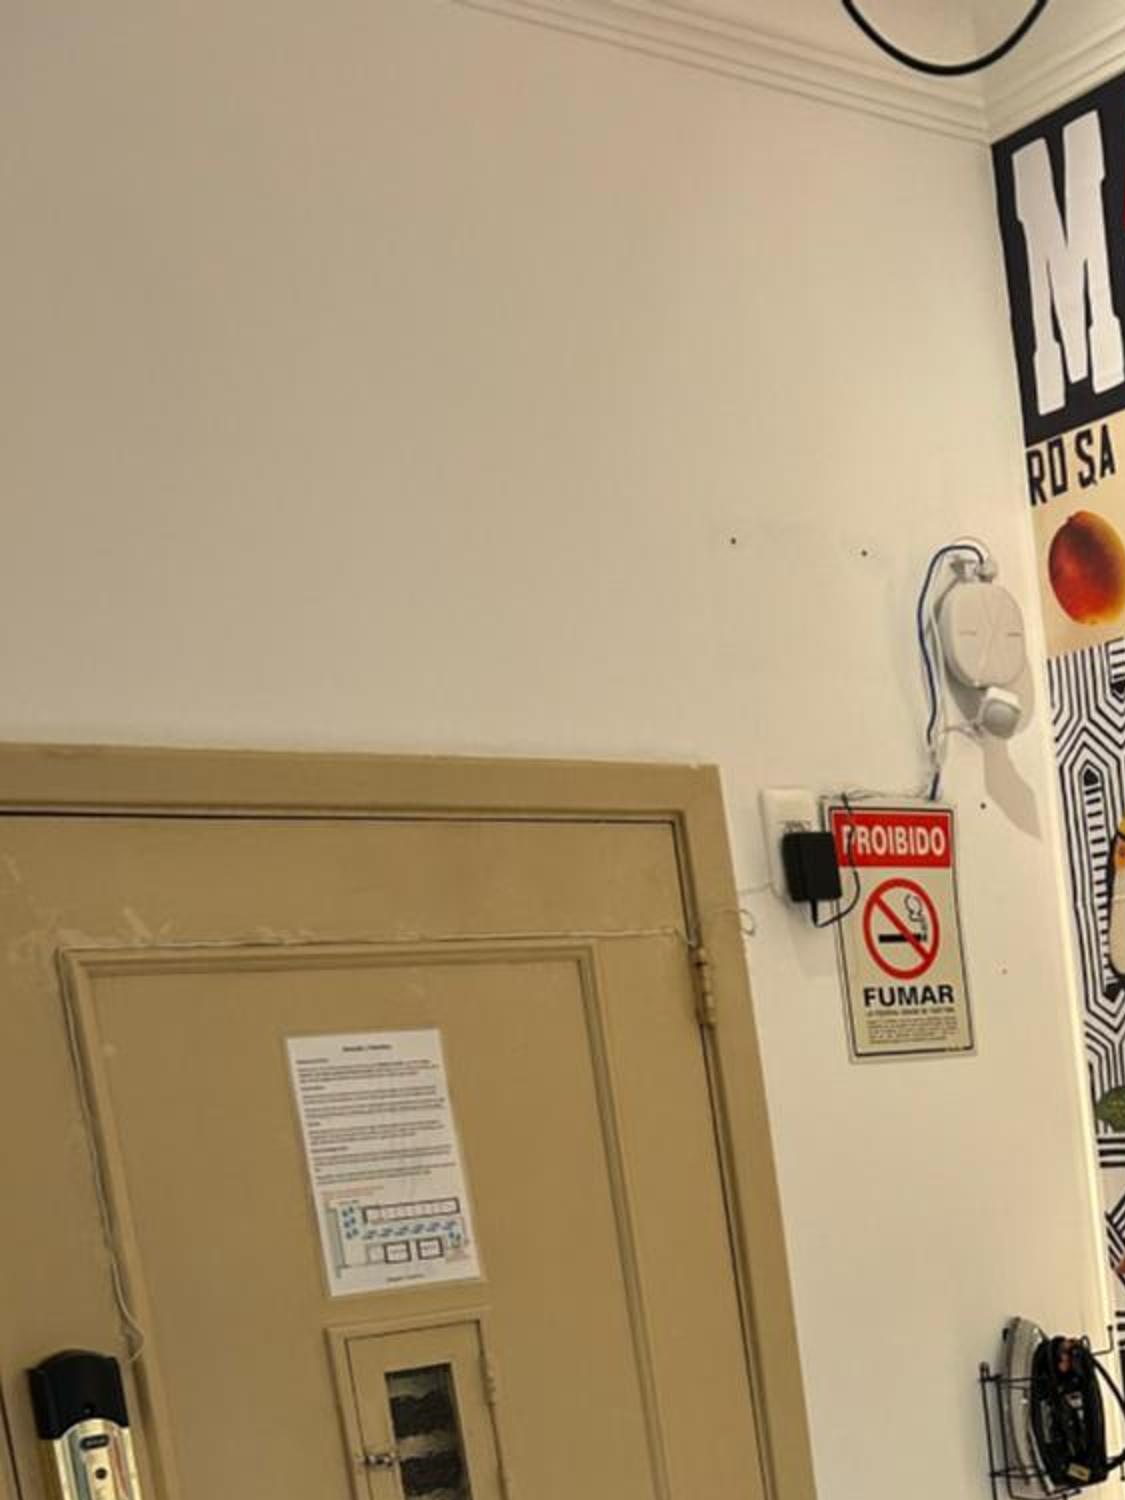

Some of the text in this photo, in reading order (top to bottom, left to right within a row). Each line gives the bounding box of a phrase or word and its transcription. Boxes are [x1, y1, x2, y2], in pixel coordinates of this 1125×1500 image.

[1025, 423, 1116, 507] ROSA
[842, 825, 946, 857] PROIBIDO
[864, 984, 955, 1008] FUMAR
